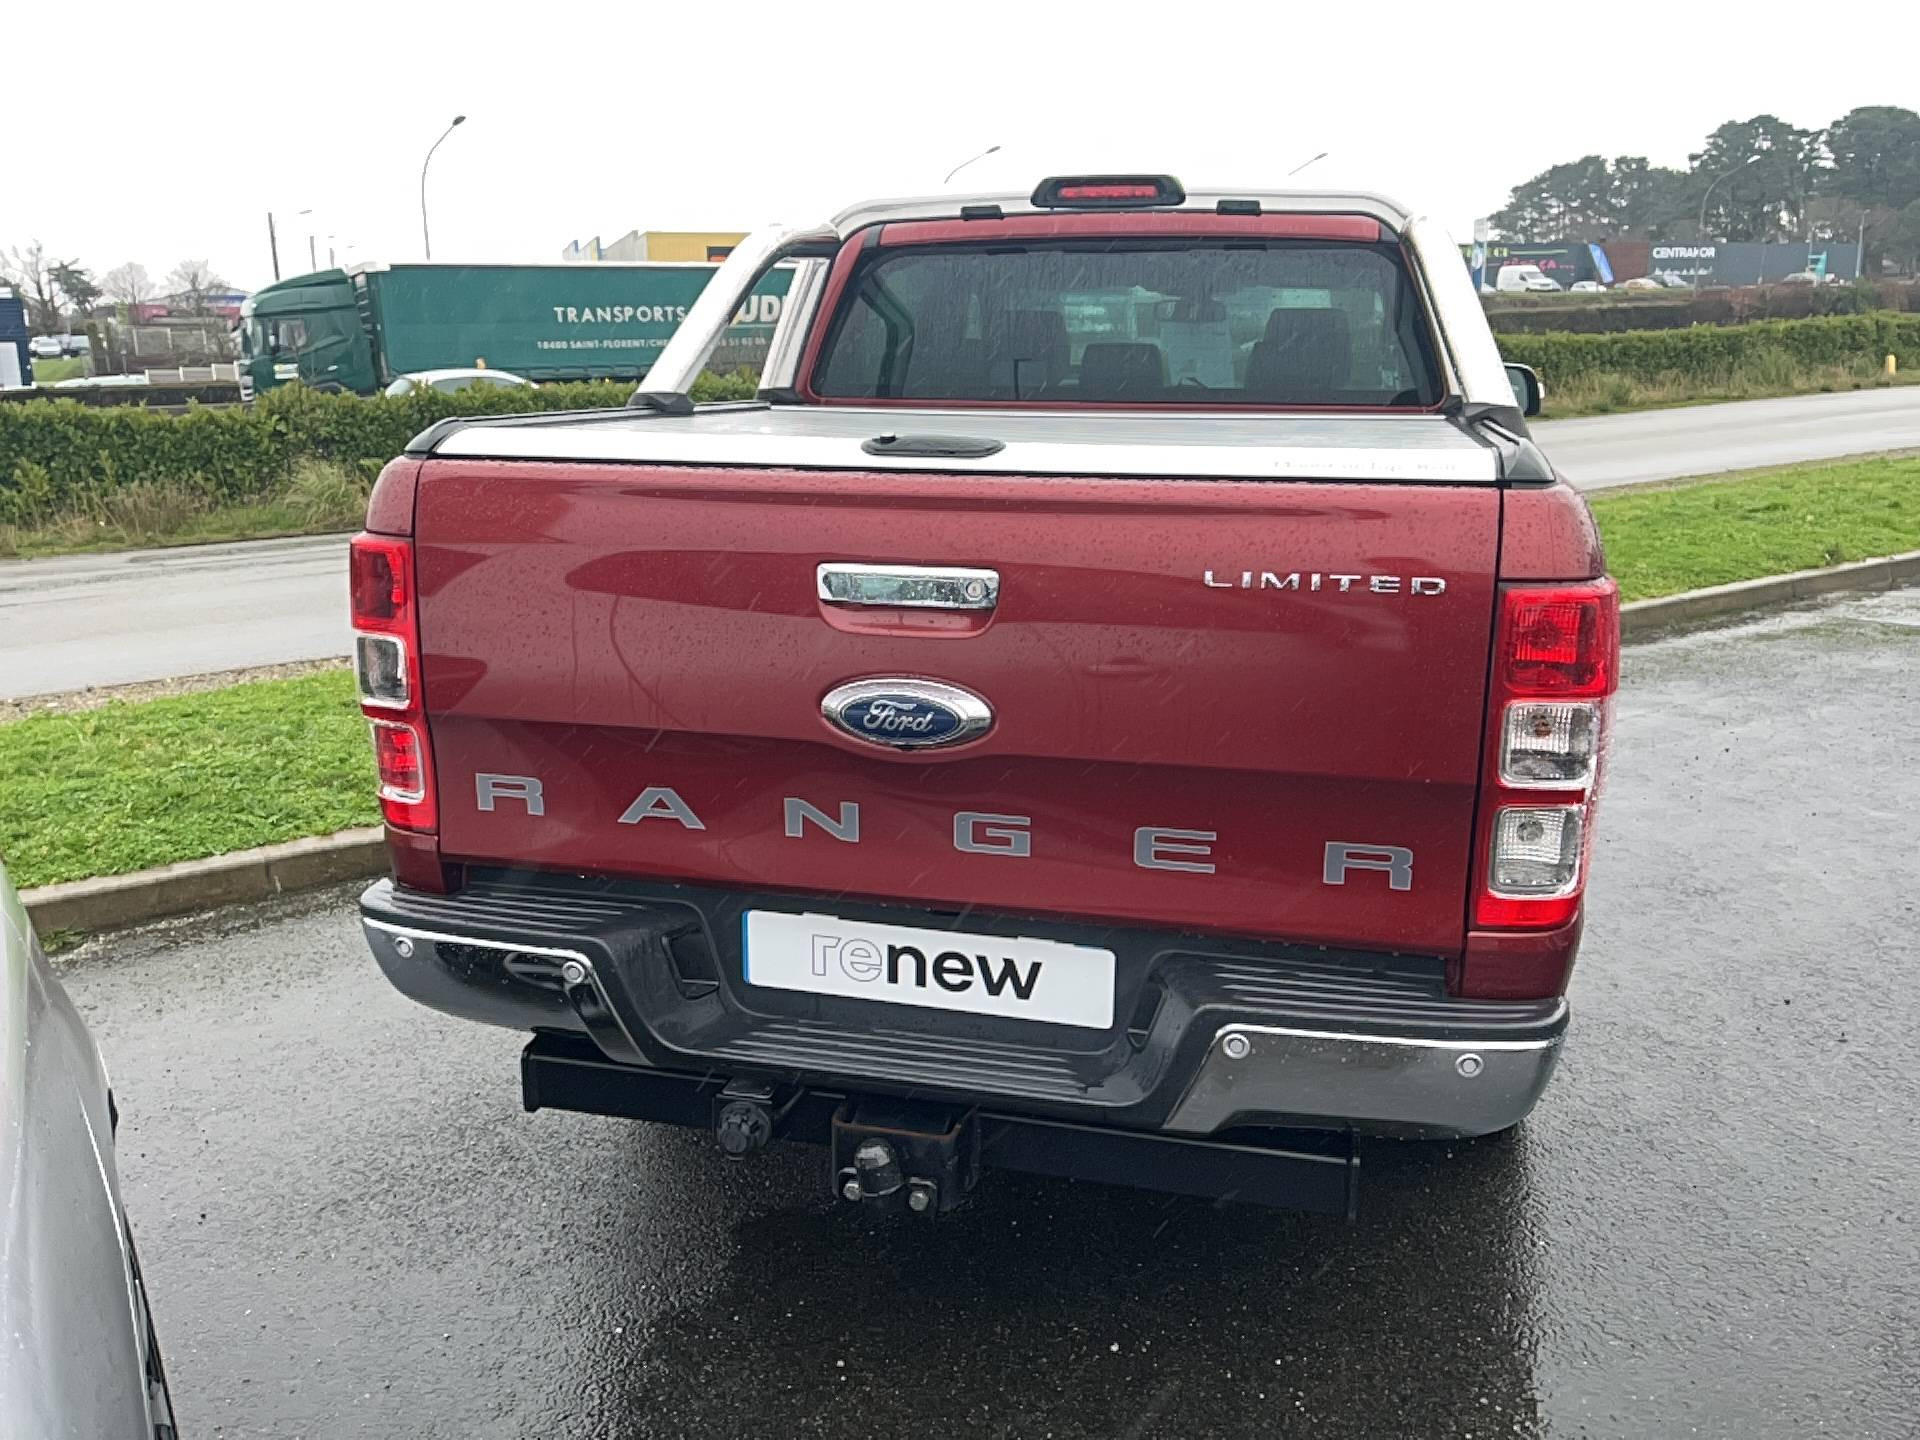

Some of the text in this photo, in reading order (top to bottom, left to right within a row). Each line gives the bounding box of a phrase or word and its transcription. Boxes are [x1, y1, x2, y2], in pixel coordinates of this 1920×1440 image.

[1653, 246, 1715, 259] CENTRAKOR
[553, 306, 686, 323] TRANSPORTS
[1203, 569, 1448, 596] LIMITED
[863, 699, 936, 732] Ford
[474, 772, 1414, 891] RANGER
[811, 933, 1043, 1001] renew
